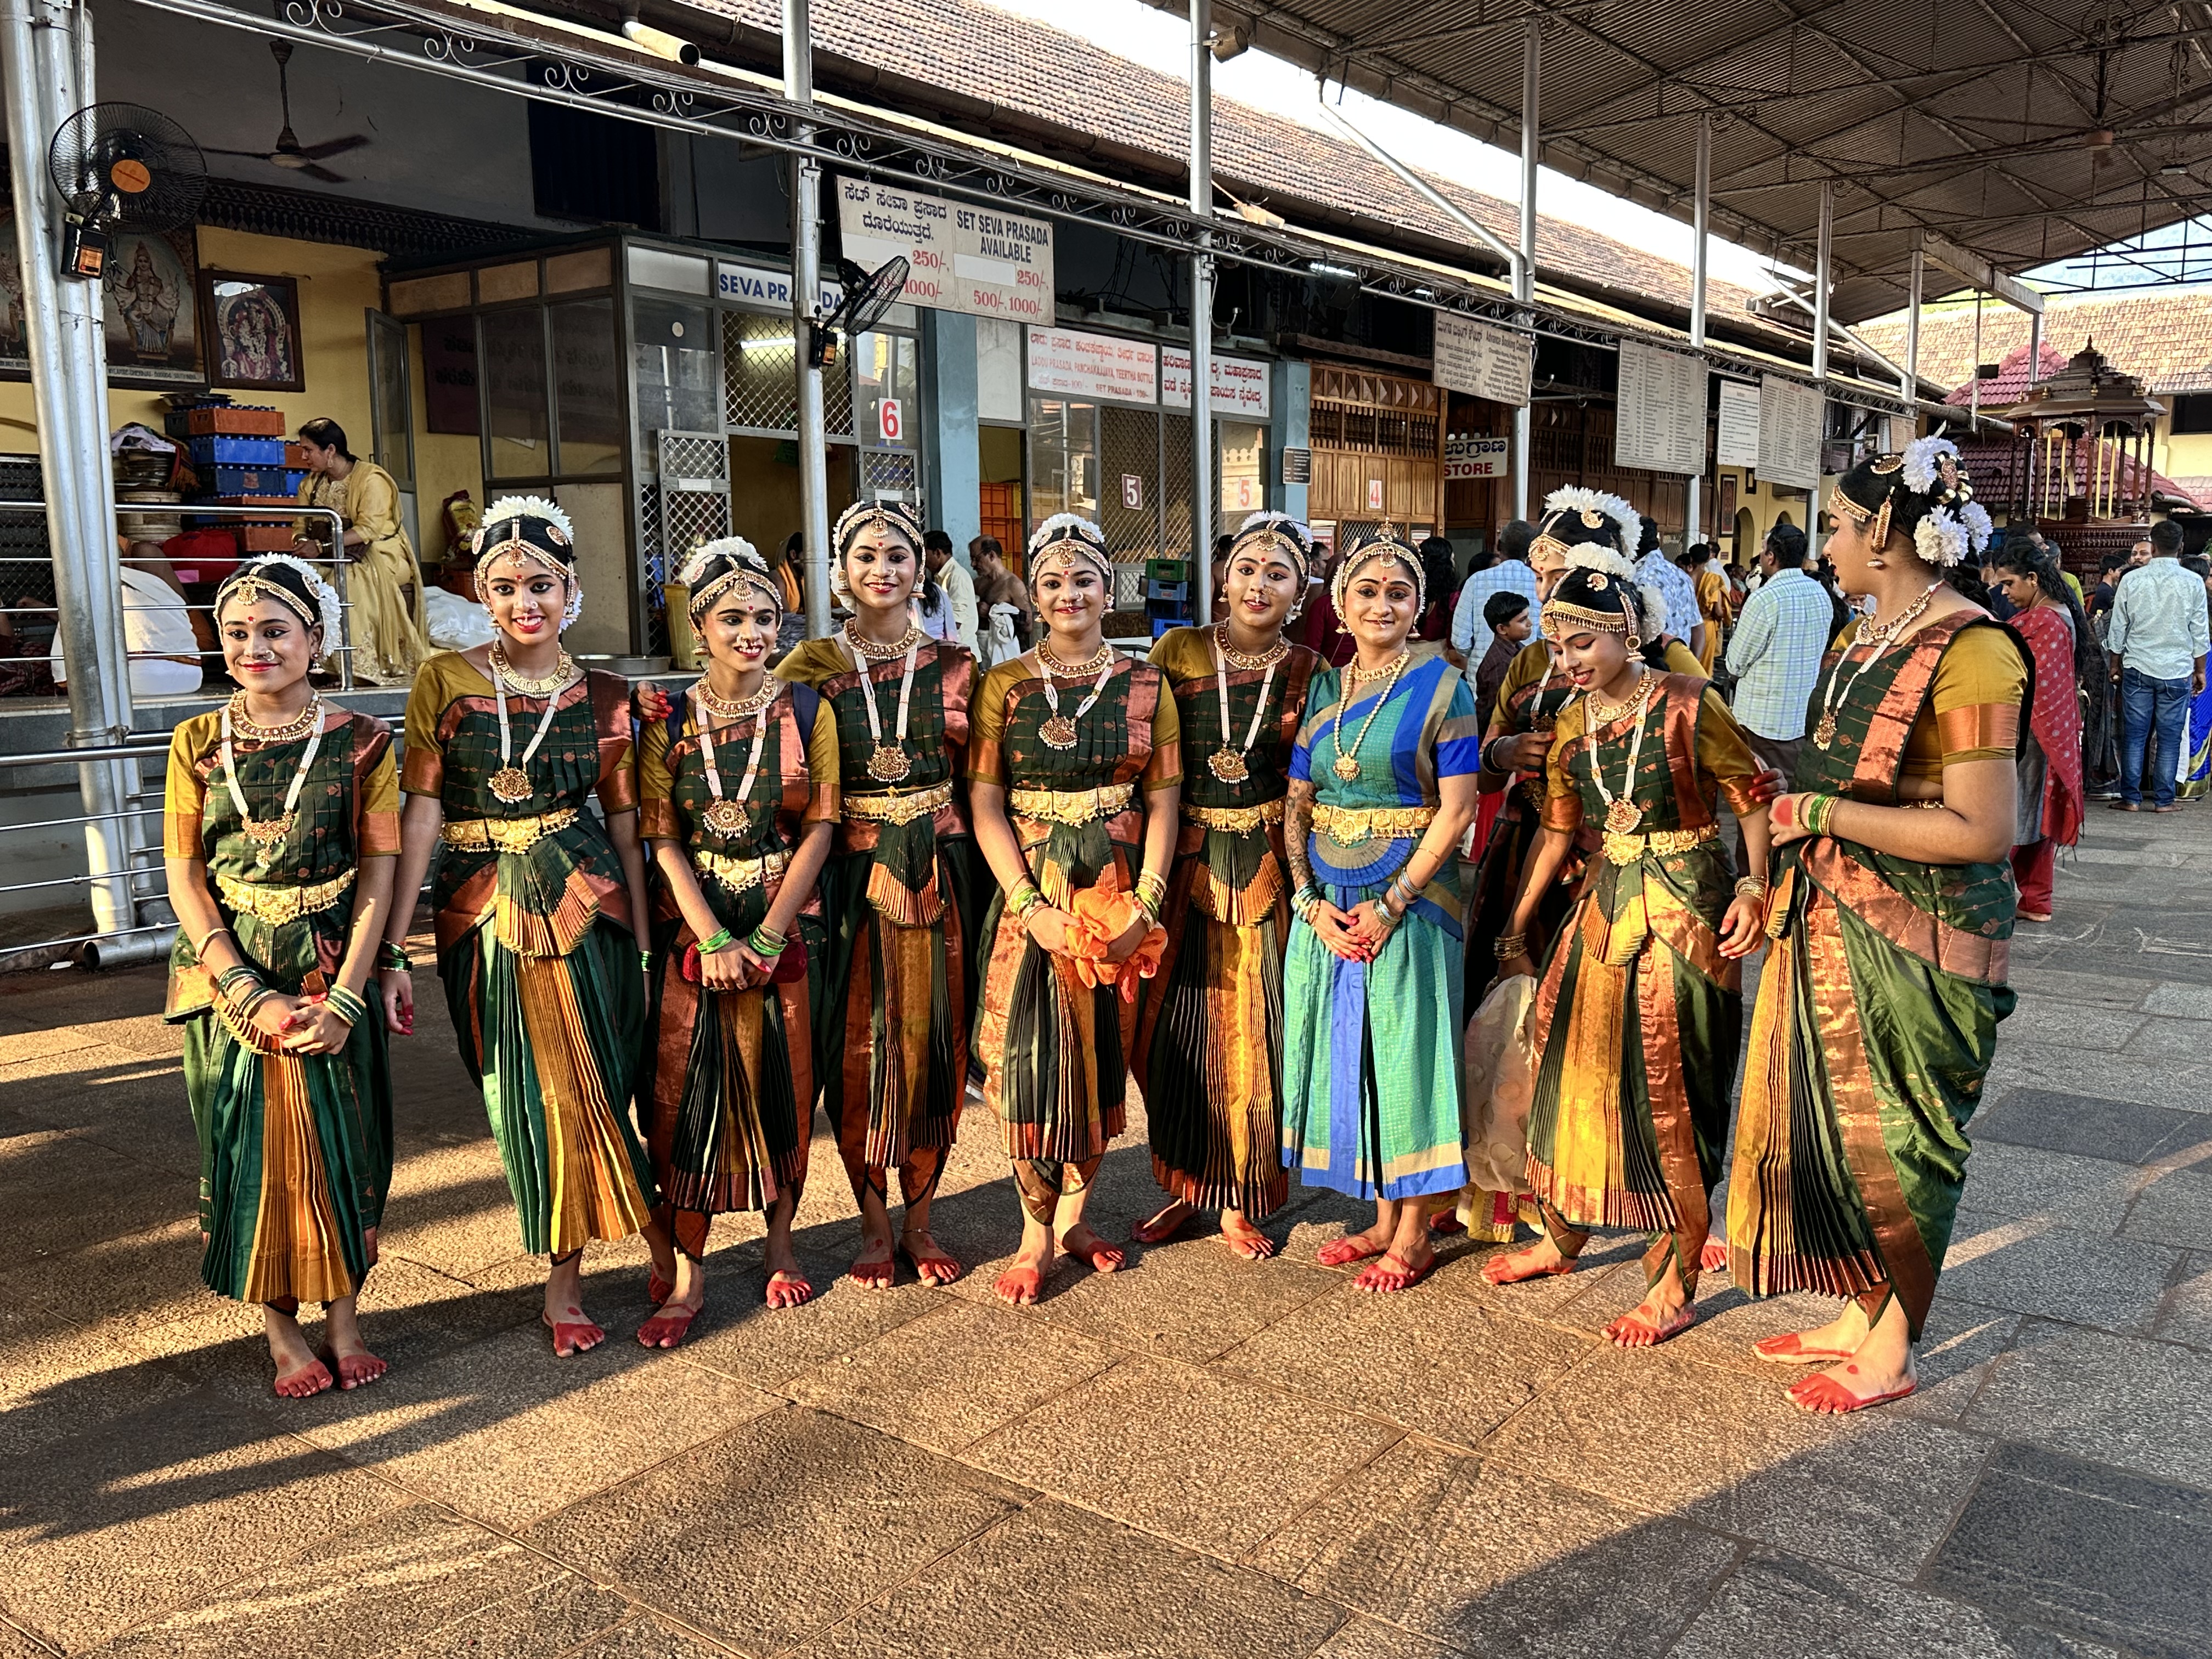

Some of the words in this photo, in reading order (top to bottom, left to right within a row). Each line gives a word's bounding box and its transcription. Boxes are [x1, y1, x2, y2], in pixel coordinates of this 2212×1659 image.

[844, 182, 870, 202] ಸೆಟ್
[876, 189, 908, 211] ಸೇವಾ
[913, 198, 947, 219] ಪ್ರಸಾದ
[862, 211, 934, 244] ದೊರೆಯುತ್ತದೆ.
[957, 210, 975, 230] SET
[978, 215, 1003, 237] SEVA
[1006, 221, 1048, 246] PRASADA
[980, 236, 1031, 263] AVAILABLE
[720, 274, 765, 298] SEVA
[1009, 297, 1042, 319] 1000/-
[1116, 368, 1136, 381] TEERTHA
[1137, 372, 1154, 384] BOTTLE
[1096, 383, 1106, 392] SET
[1108, 385, 1132, 396] PRASADA
[882, 401, 899, 437] 6
[1445, 441, 1506, 458] ಉಗ್ರಾಣ
[1444, 462, 1493, 477] STORE
[1126, 478, 1138, 506] 5
[1240, 479, 1250, 507] 5
[1370, 482, 1380, 506] 4
